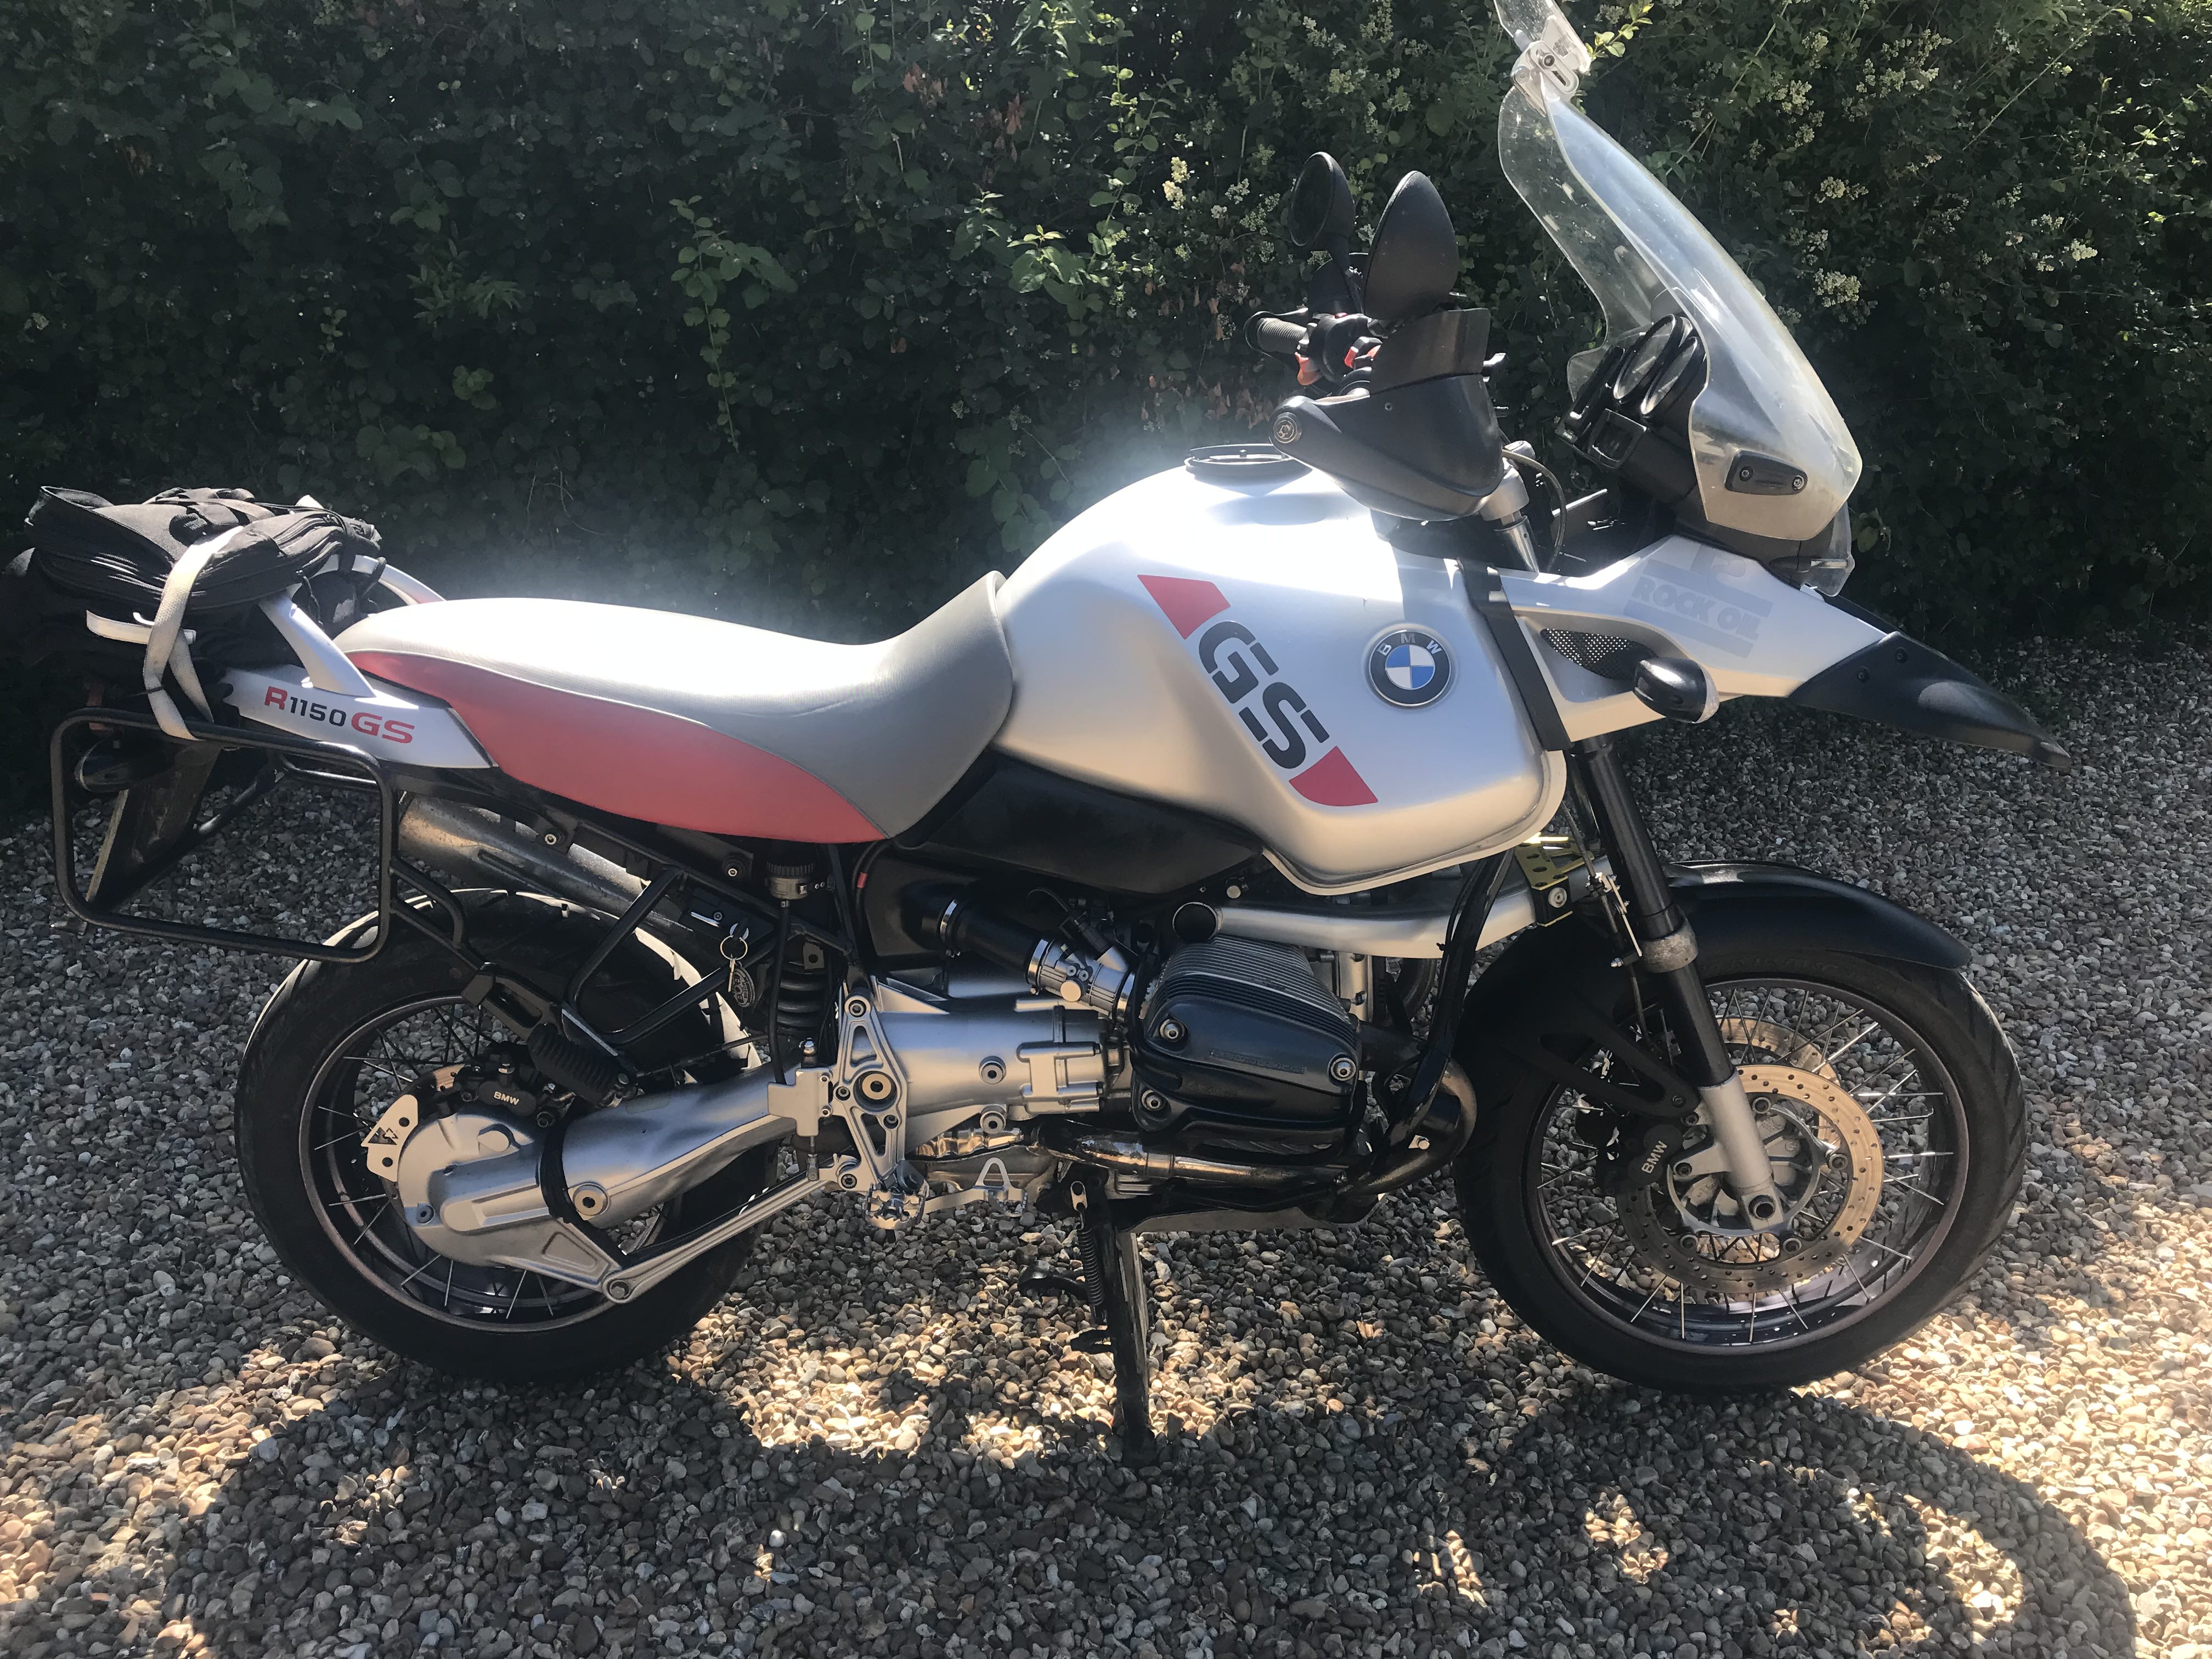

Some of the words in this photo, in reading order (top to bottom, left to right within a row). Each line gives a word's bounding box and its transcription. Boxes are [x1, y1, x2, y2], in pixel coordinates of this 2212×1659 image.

[1632, 577, 1717, 623] ROCK
[1717, 607, 1761, 640] OIL
[1376, 633, 1442, 656] BMW
[1198, 620, 1330, 769] GS
[493, 1091, 520, 1105] BMW
[1641, 1140, 1668, 1174] BMW
